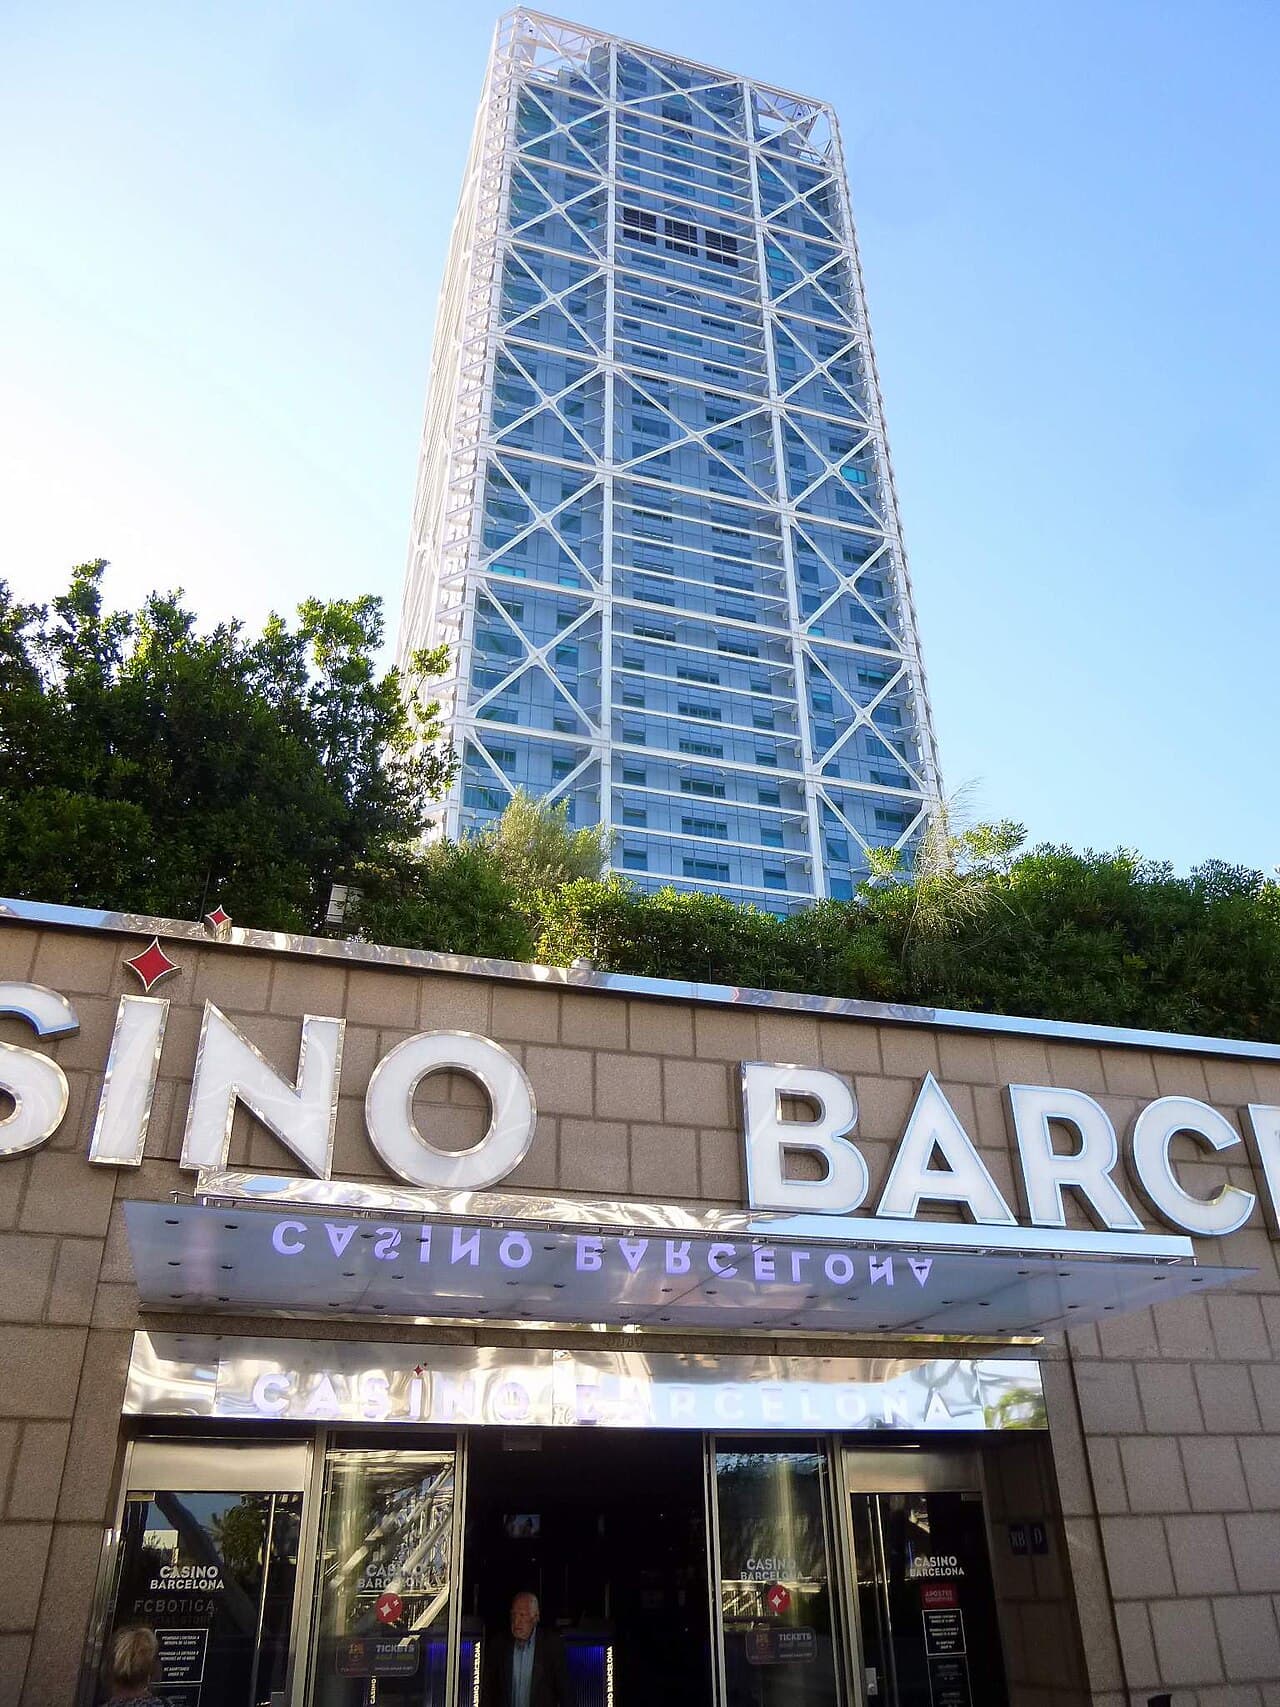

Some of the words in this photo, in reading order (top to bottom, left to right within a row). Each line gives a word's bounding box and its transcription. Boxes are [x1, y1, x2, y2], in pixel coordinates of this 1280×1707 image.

[252, 1372, 530, 1420] CASINO
[746, 1558, 796, 1571] CASINO
[914, 1555, 958, 1567] CASINO
[160, 1565, 219, 1579] CASINO
[366, 1564, 423, 1577] CASNO
[150, 1579, 225, 1590] BARCELONA
[778, 1632, 812, 1641] TICKETS
